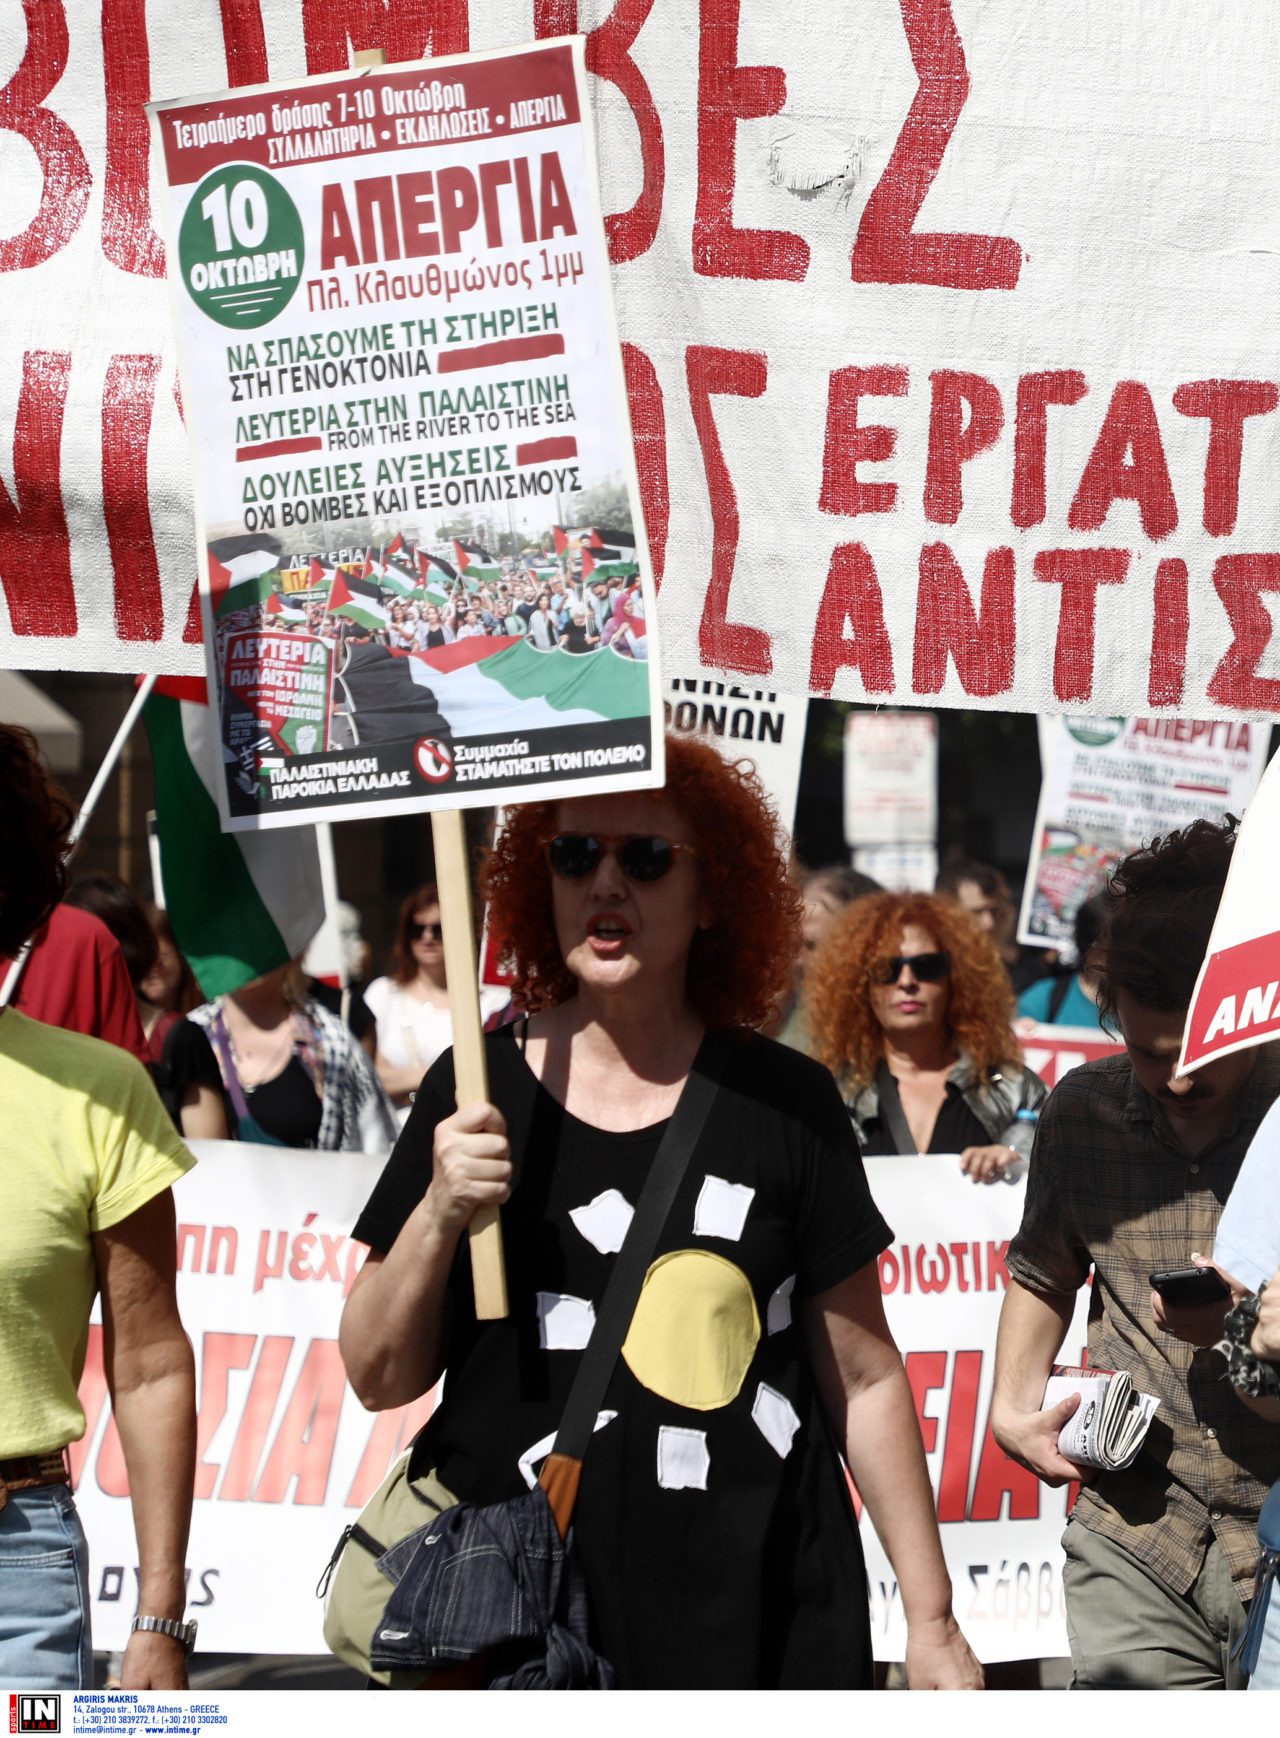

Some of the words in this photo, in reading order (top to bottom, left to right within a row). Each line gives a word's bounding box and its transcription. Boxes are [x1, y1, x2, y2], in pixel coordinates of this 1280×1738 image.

[173, 114, 266, 149] Τετραήμερο
[272, 99, 331, 132] δράσης
[337, 91, 375, 120] 7-10
[381, 80, 466, 116] Οκτώβρη
[268, 125, 377, 164] ΣΥΛΛΑΛΗΤΗΡΙΑ
[396, 107, 493, 145] ΕΚΔΗΛΩΣΕΙΣ
[509, 94, 567, 128] ΑΠΕΡΓΙΑ
[200, 179, 269, 252] 10
[320, 150, 578, 270] ΑΠΕΡΓΙΑ
[190, 249, 297, 291] ΟΚΤΩΒΡΗ
[307, 277, 350, 313] Πλ.
[355, 257, 533, 306] Κλαυθμώνος
[539, 247, 585, 288] 1μμ
[227, 343, 259, 373] ΝΑ
[263, 322, 396, 368] ΣΠΑΣΟΥΜΕ
[400, 317, 438, 347] ΤΗ
[445, 302, 560, 343] ΣΤΗΡΙΞΗ
[229, 368, 273, 402] ΣΤΗ
[278, 350, 432, 393] ΓΕΝΟΚΤΟΝΙΑ
[235, 405, 341, 444] ΛΕΥΤΕΡΙΑ
[345, 394, 409, 428] ΣΤΗΝ
[419, 374, 571, 418] ΠΑΛΑΙΣΤΙΝΗ
[327, 425, 375, 452] FROM
[379, 420, 412, 443] THE
[417, 413, 472, 440] RIVER
[475, 409, 500, 431] TO
[503, 405, 540, 428] THE
[544, 401, 577, 423] SEA
[241, 461, 366, 504] ΔΟΥΛΕΙΕΣ
[376, 444, 511, 486] ΑΥΞΗΣΕΙΣ
[243, 501, 276, 533] ΟΧΙ
[282, 492, 369, 528] ΒΟΜΒΕΣ
[373, 486, 409, 513] ΚΑΙ
[415, 466, 583, 510] ΕΞΟΠΛΙΣΜΟΥΣ
[231, 637, 327, 665] ΛΕΥΤΕΡΙΑ
[230, 669, 326, 693] ΠΑΛΑΙΣΤΙΝΗ
[269, 757, 378, 783] ΠΑΛΑΙΣΤΙΝΙΑΚΗ
[453, 738, 529, 762] Συμμαχία
[455, 755, 551, 782] ΣΤΑΜΑΤΗΣΤΕ
[552, 750, 581, 770] ΤΟΝ
[584, 744, 646, 768] ΠΟΛΕΜΟ
[271, 778, 335, 800] ΠΑΡΟΙΚΙΑ
[337, 770, 411, 793] ΕΛΛΑΔΑΣ
